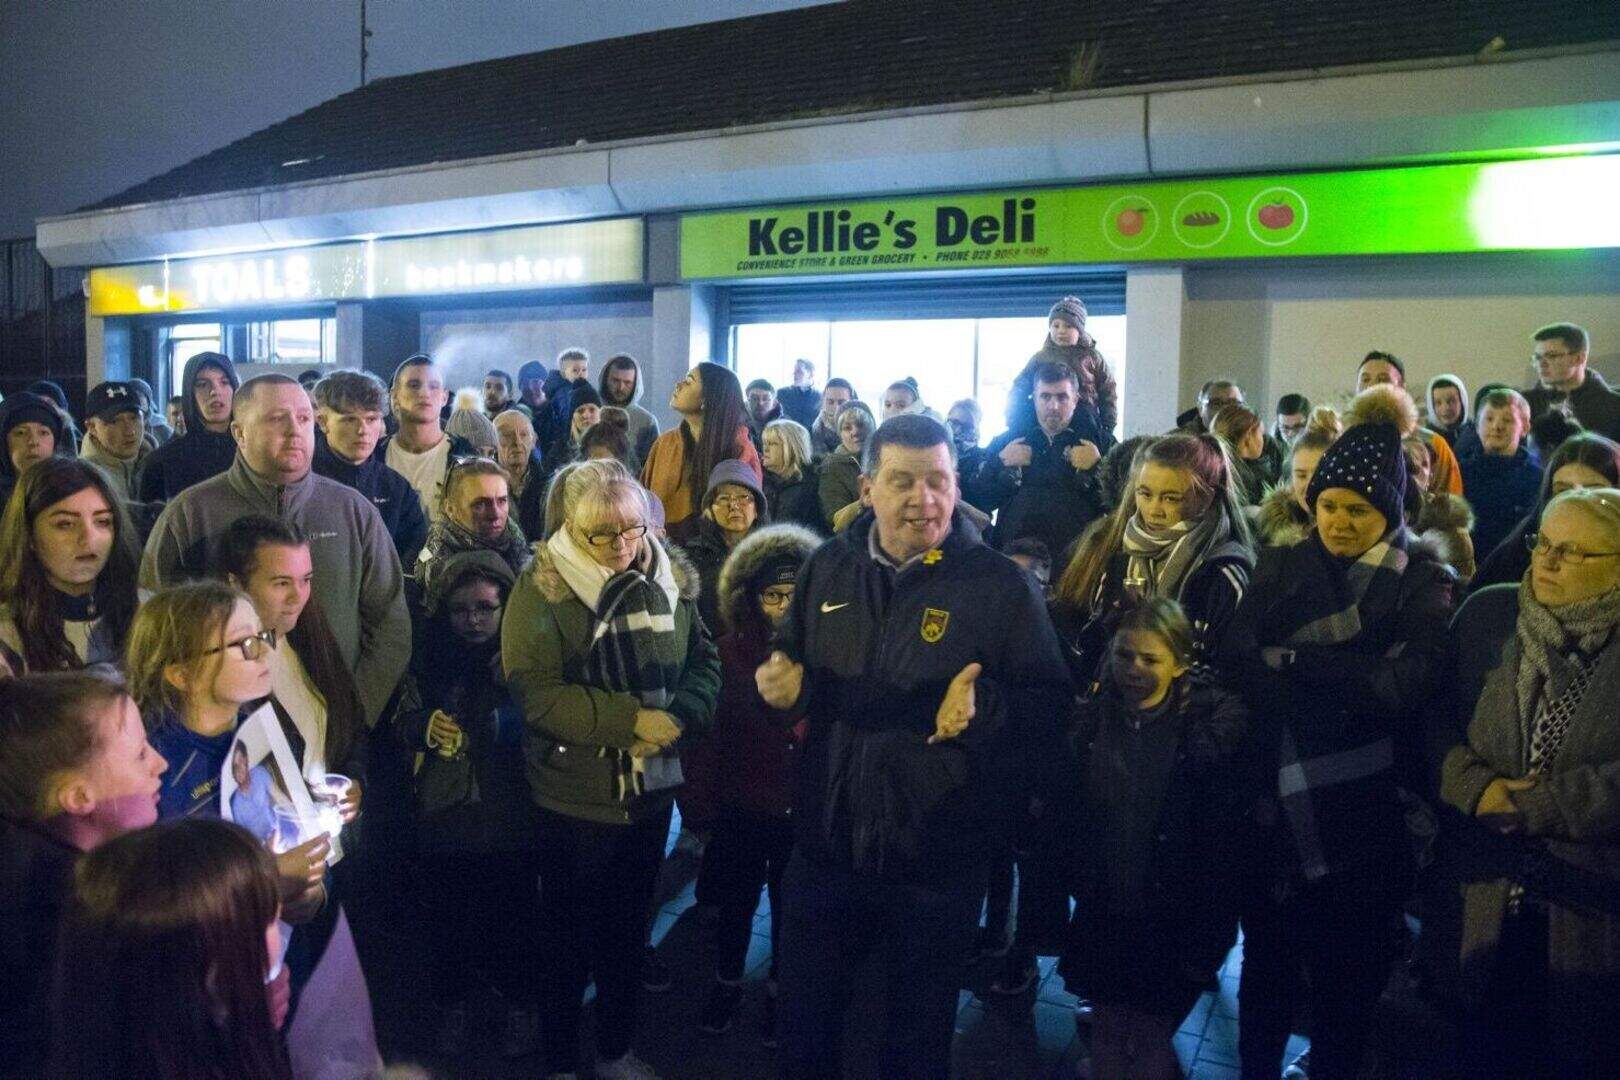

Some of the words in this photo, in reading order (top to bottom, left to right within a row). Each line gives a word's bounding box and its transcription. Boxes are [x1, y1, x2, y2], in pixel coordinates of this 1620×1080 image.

[749, 209, 917, 256] Kellie's
[936, 198, 1036, 247] Deli
[192, 254, 310, 303] TOALS
[736, 258, 796, 271] CONVENIENCE
[829, 257, 836, 266] &
[839, 255, 870, 266] GREEN
[871, 253, 917, 264] GROCERY
[936, 250, 970, 262] PHONE
